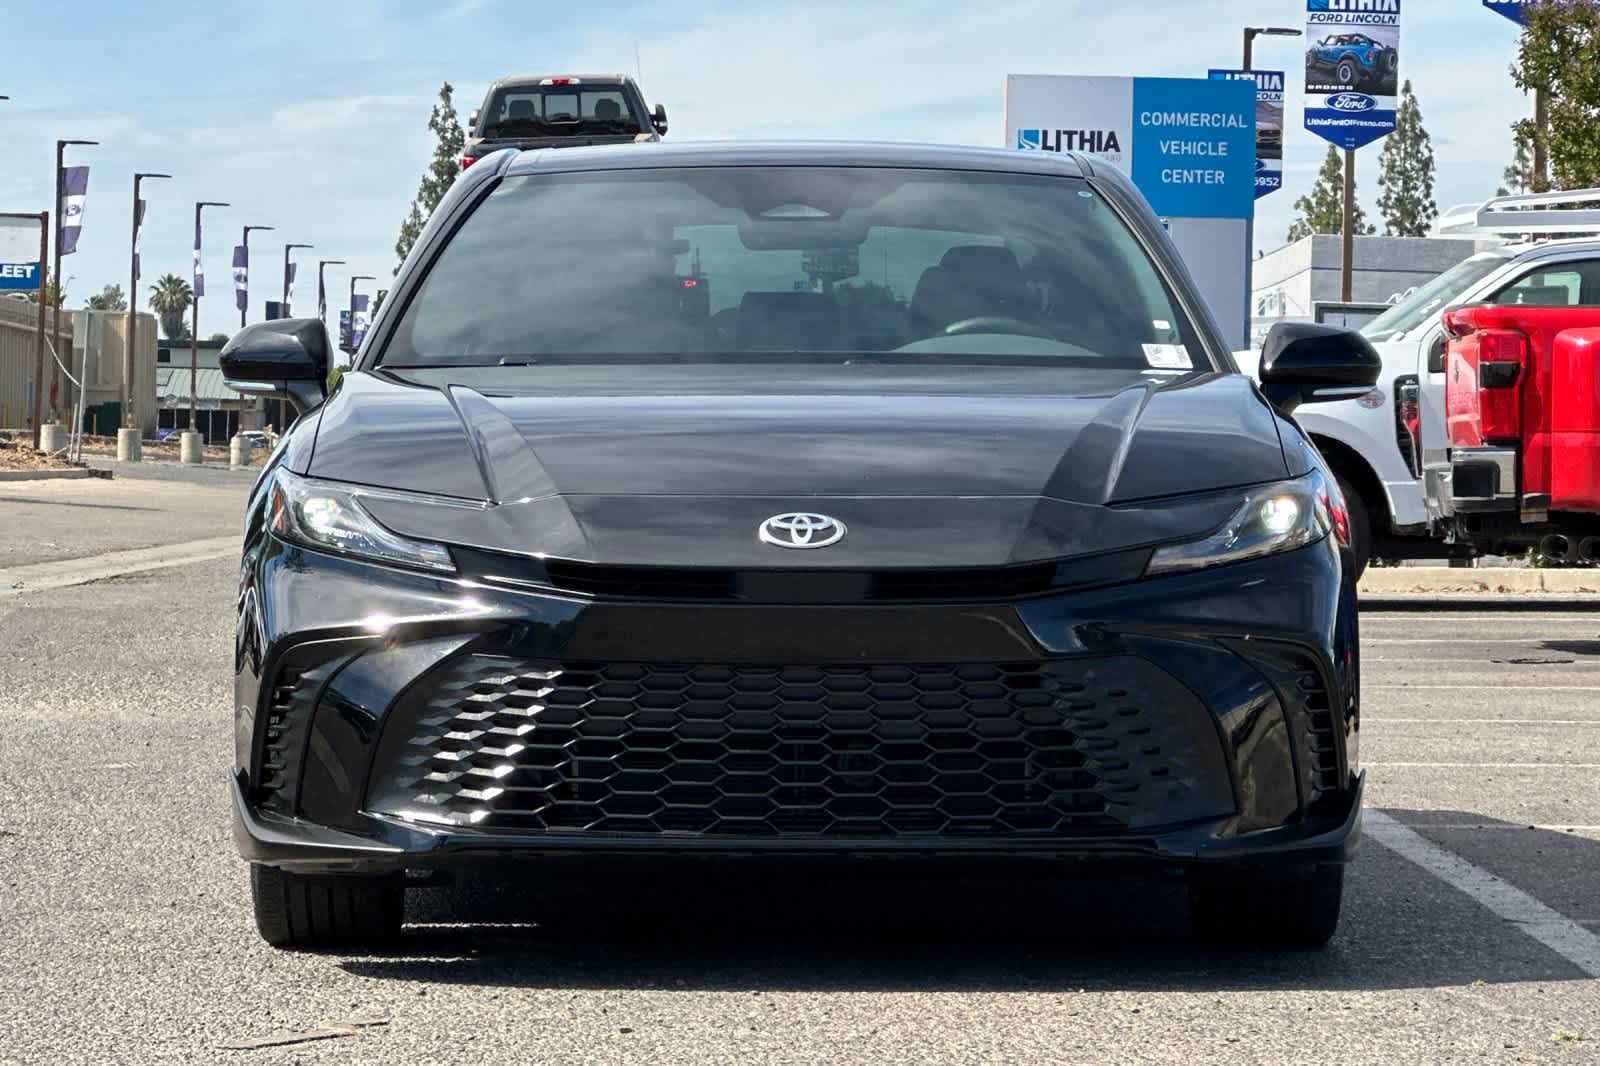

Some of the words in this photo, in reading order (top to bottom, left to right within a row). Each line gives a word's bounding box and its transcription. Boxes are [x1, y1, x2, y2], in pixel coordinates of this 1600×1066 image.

[1310, 13, 1343, 23] FORD
[1345, 14, 1397, 25] LINCOLN
[1334, 94, 1368, 109] Ford
[1140, 111, 1248, 128] COMMERCIAL
[1041, 129, 1121, 153] LITHIA
[1159, 139, 1228, 156] VEHICLE
[1161, 168, 1225, 185] CENTER
[0, 264, 36, 279] EET
